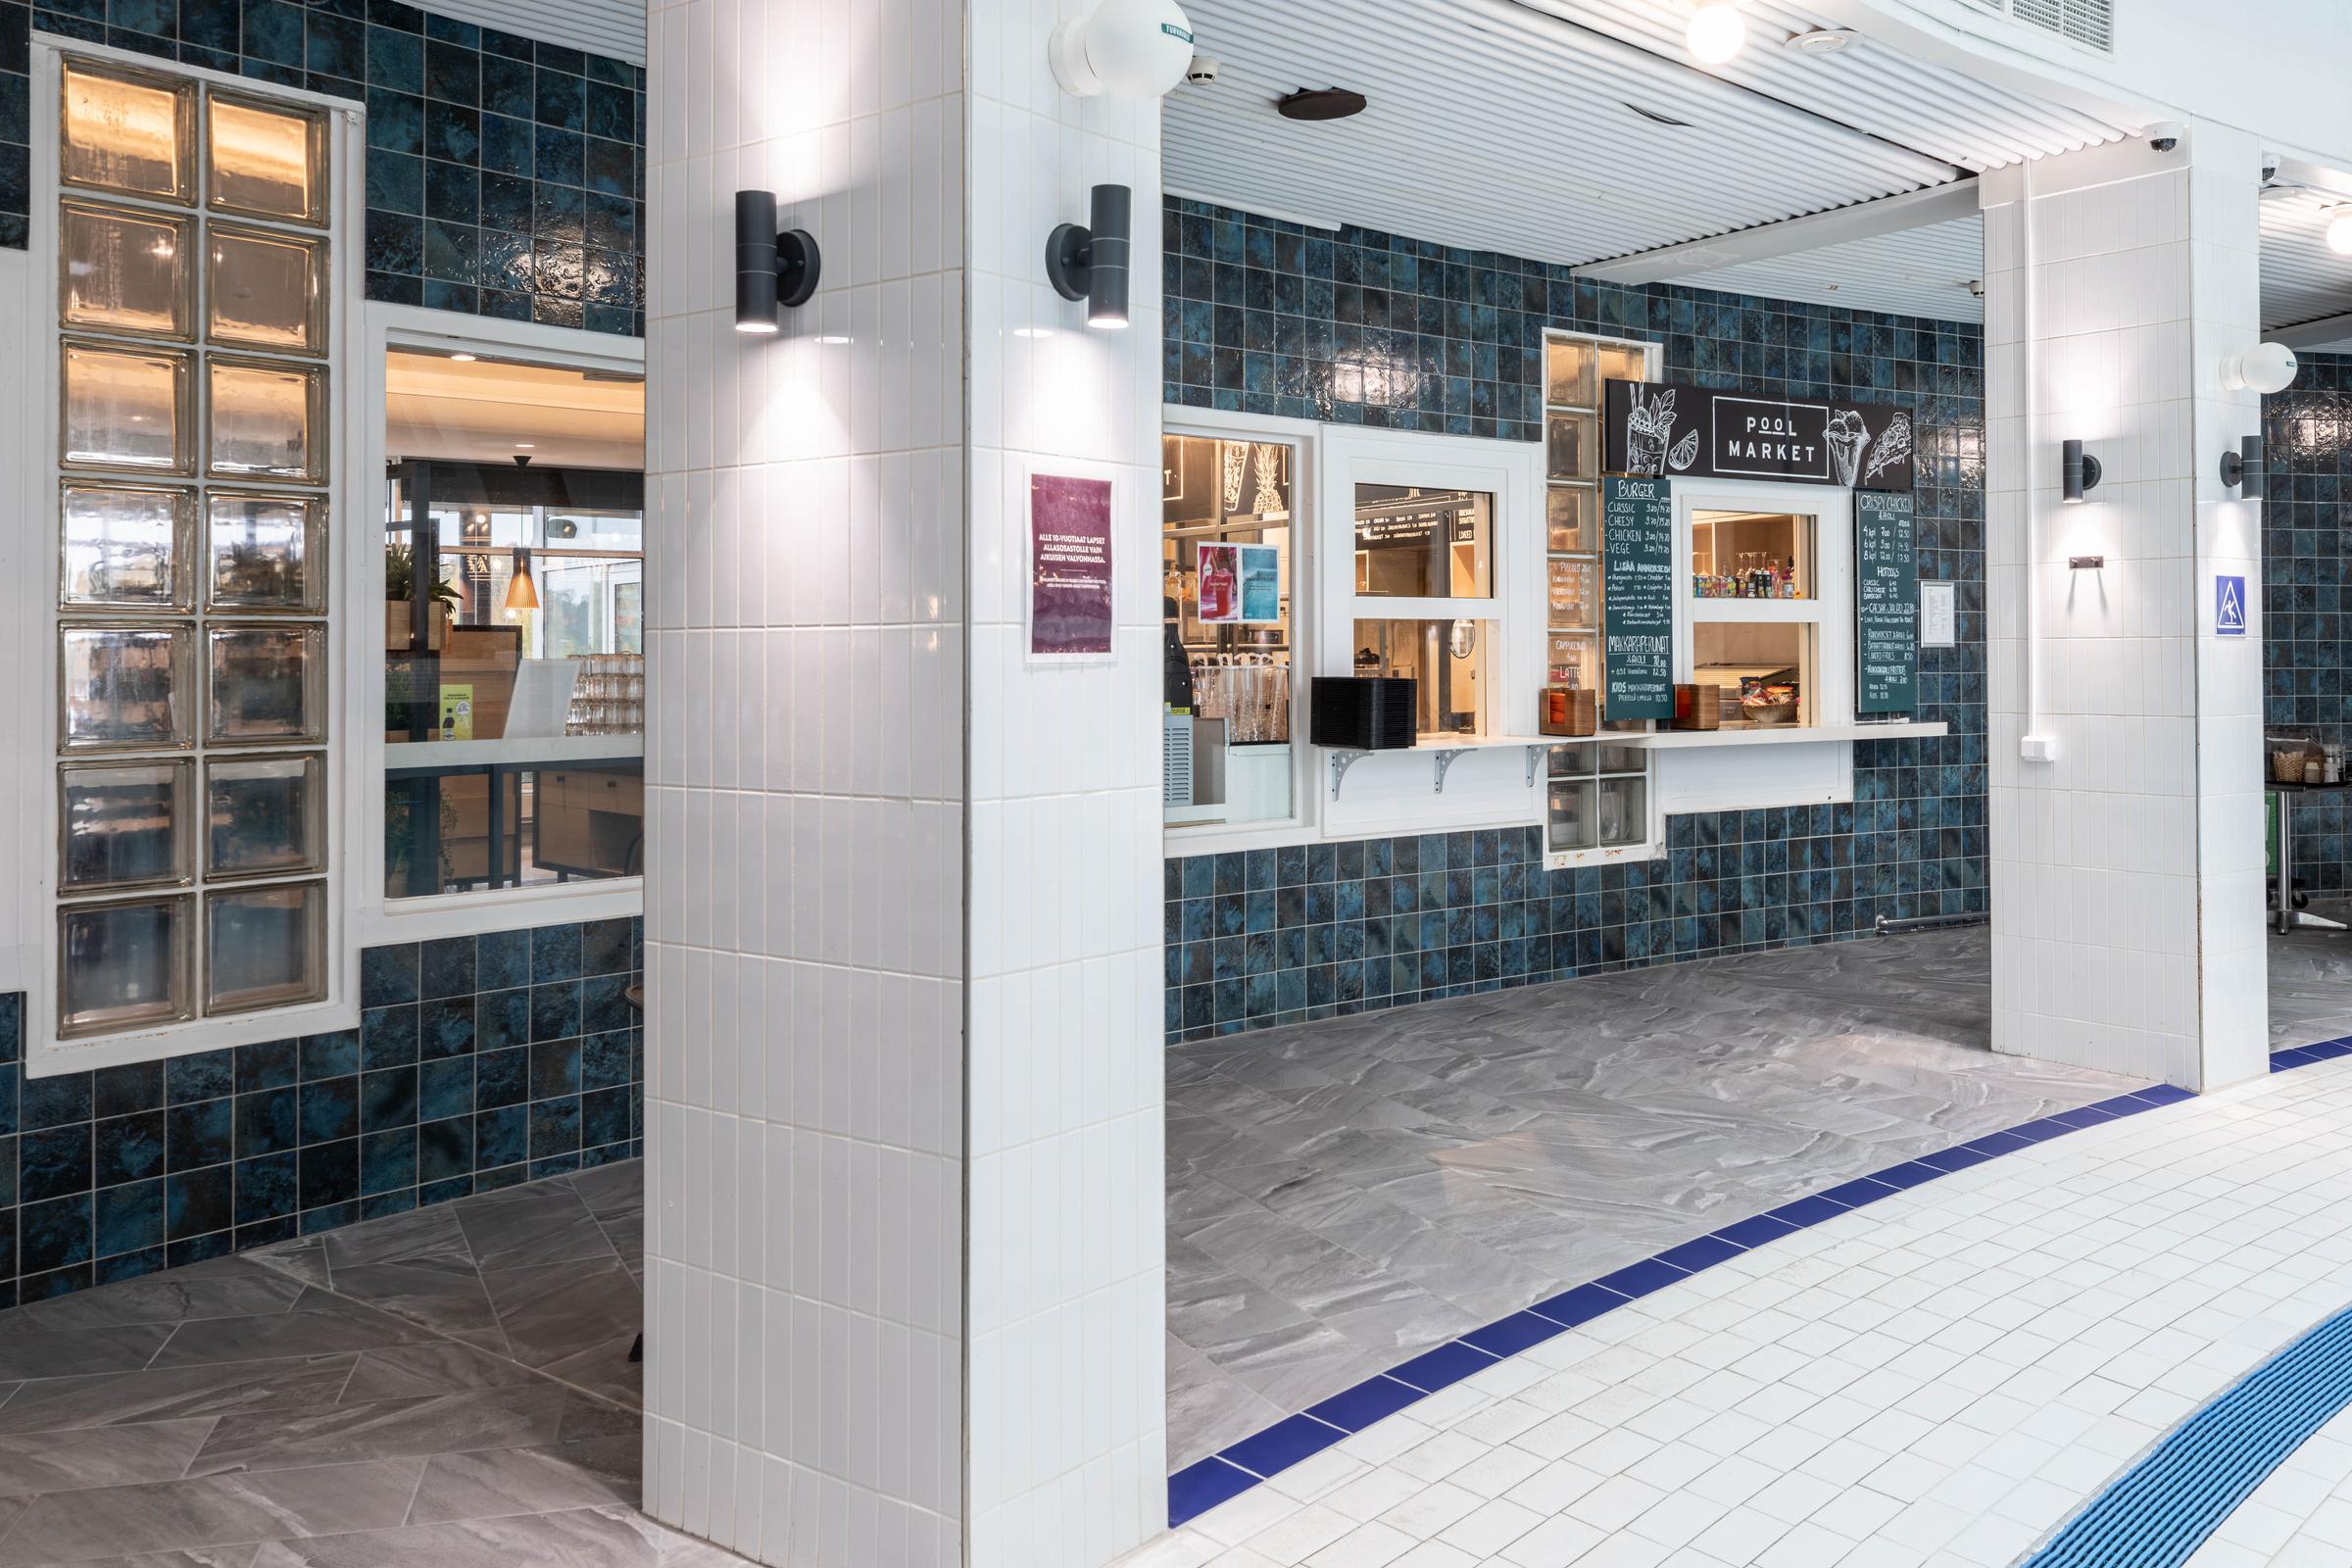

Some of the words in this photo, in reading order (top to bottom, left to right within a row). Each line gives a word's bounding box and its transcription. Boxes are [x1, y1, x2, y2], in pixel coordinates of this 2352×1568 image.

[1746, 416, 1797, 436] POOL
[1729, 440, 1815, 463] MARKET
[1618, 479, 1655, 499] BURGER
[1607, 501, 1636, 514] CLASSIC
[1608, 514, 1635, 526] CHEESY
[1039, 533, 1052, 542] ALLE
[1087, 536, 1105, 545] LAPSET
[1608, 528, 1642, 542] CHICKEN
[1044, 544, 1089, 554] ALLASOSASTOLLE
[1609, 542, 1631, 556] VEGE
